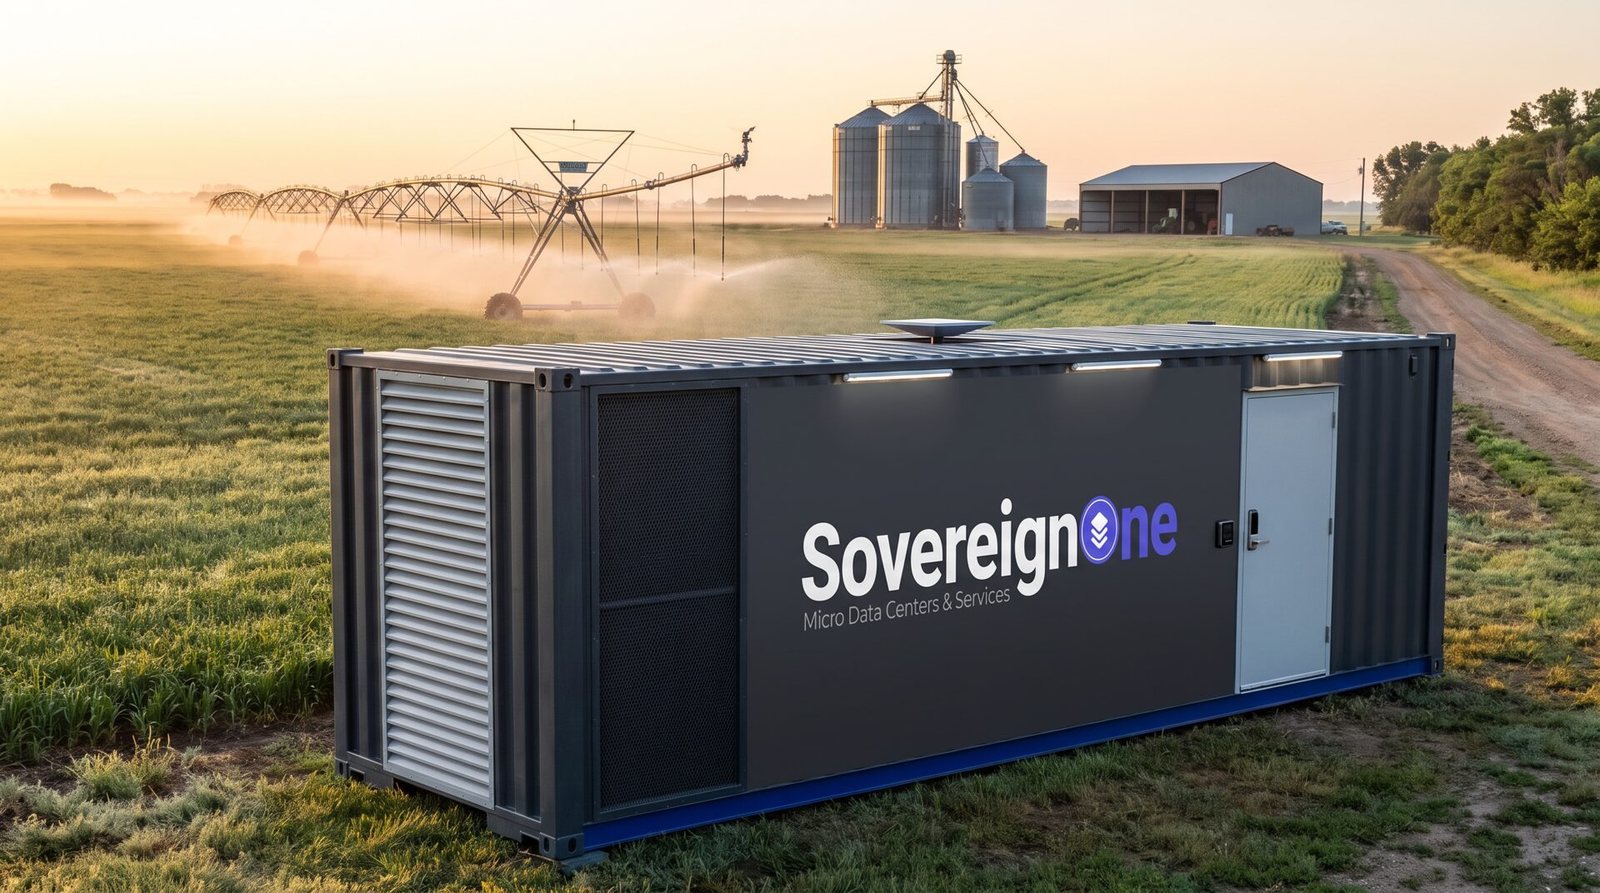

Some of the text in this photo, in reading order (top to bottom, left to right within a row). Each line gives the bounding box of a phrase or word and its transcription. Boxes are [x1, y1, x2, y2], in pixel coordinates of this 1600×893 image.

[803, 587, 1011, 632] Micro Data Centers & Services
